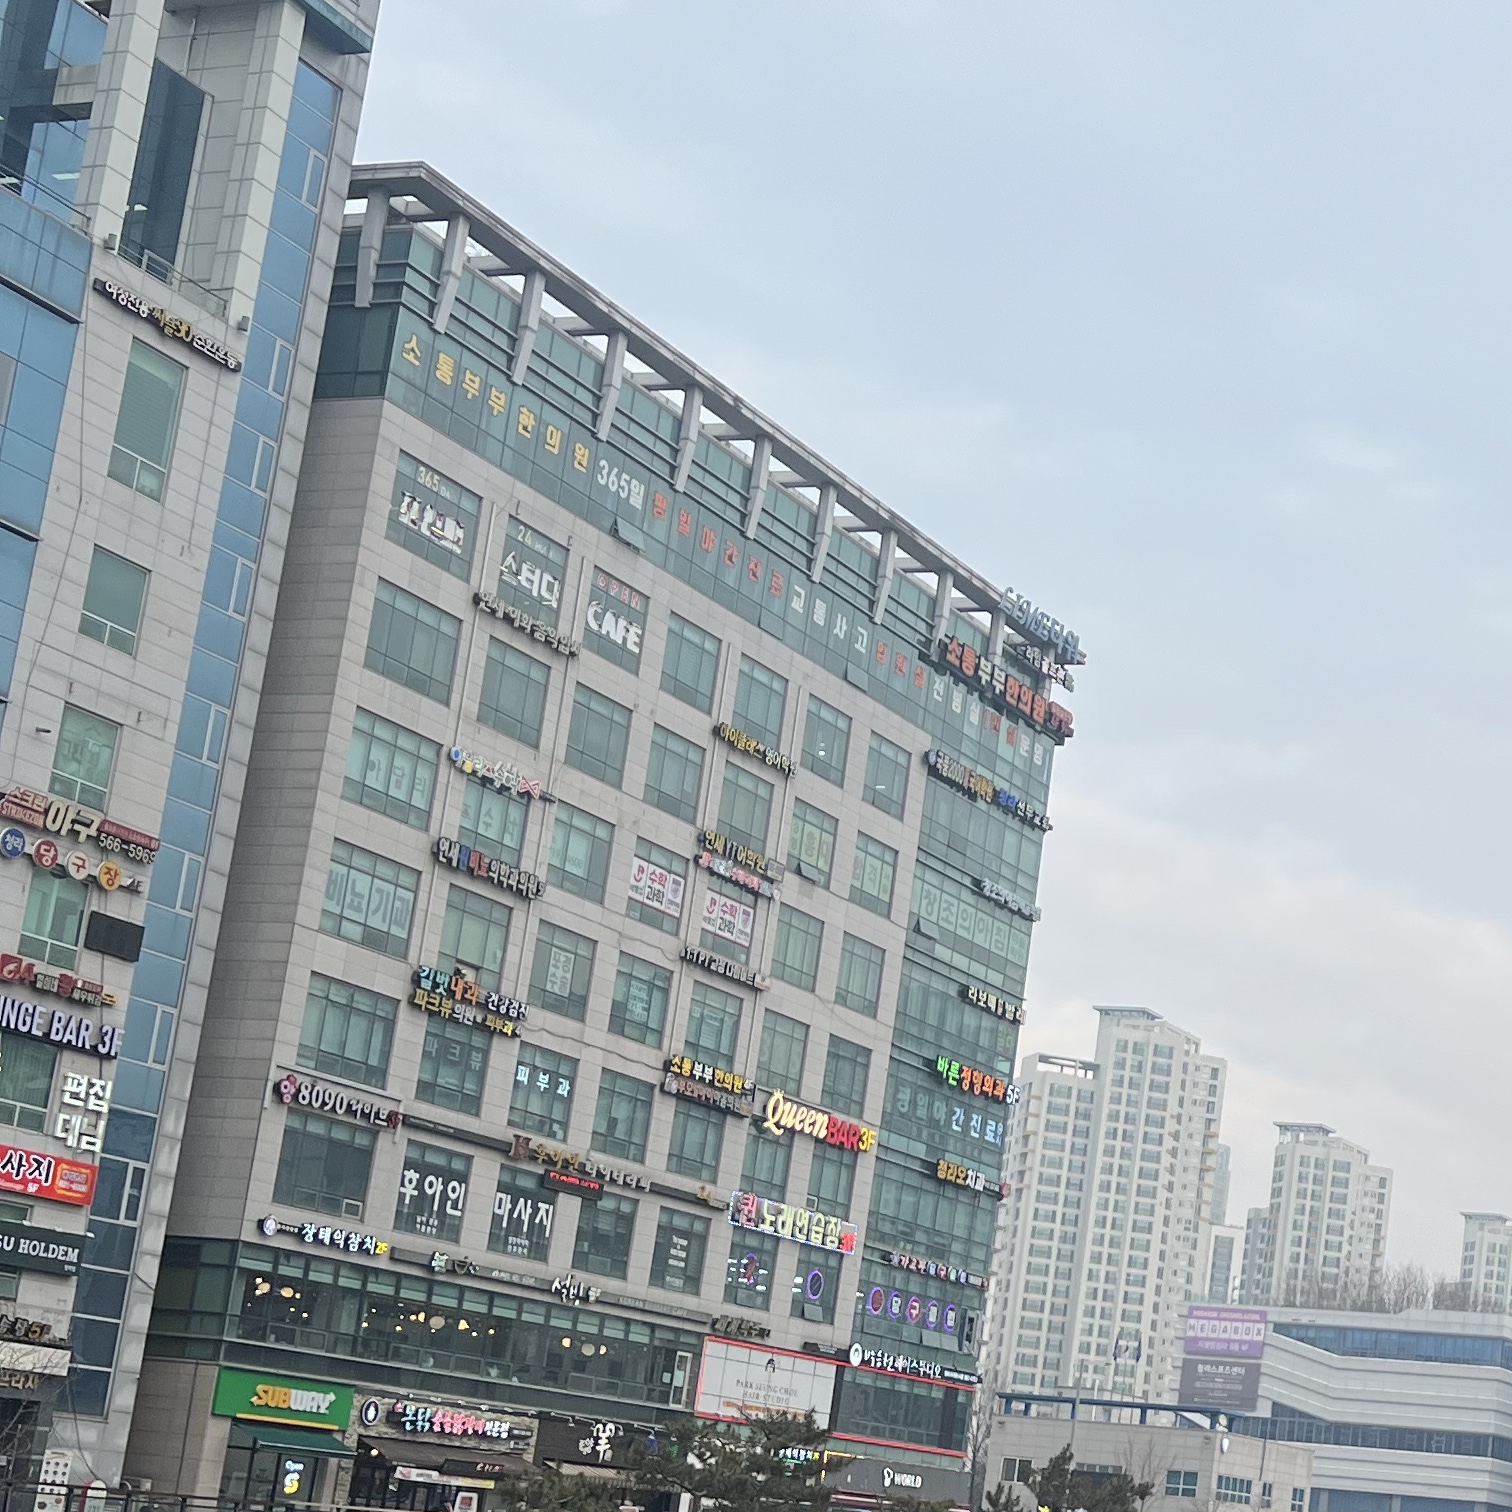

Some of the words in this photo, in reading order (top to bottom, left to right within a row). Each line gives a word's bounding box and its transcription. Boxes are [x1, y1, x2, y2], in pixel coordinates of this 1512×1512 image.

[594, 454, 646, 511] 365일
[584, 595, 644, 656] CAFE
[944, 632, 1047, 726] 소통부부한의원
[46, 800, 103, 844] 야구
[50, 1010, 93, 1050] BAR
[98, 1026, 125, 1057] 3F
[513, 1062, 573, 1100] 피부과
[668, 1051, 744, 1095] 소통부부한의원
[934, 1053, 1007, 1106] 바른정형외과
[1004, 1082, 1021, 1107] 5F
[295, 1079, 349, 1117] 8090
[760, 1084, 831, 1150] Queen
[825, 1113, 862, 1153] BAR
[857, 1125, 877, 1154] 3F
[396, 1166, 467, 1218] 후아인
[489, 1190, 555, 1239] 마사지
[757, 1196, 843, 1250] 노래연습장
[19, 1238, 78, 1263] HOLDEM
[1187, 1322, 1263, 1337] MEGABOX
[248, 1381, 338, 1416] SUBWAY
[892, 1471, 923, 1489] WORLD
